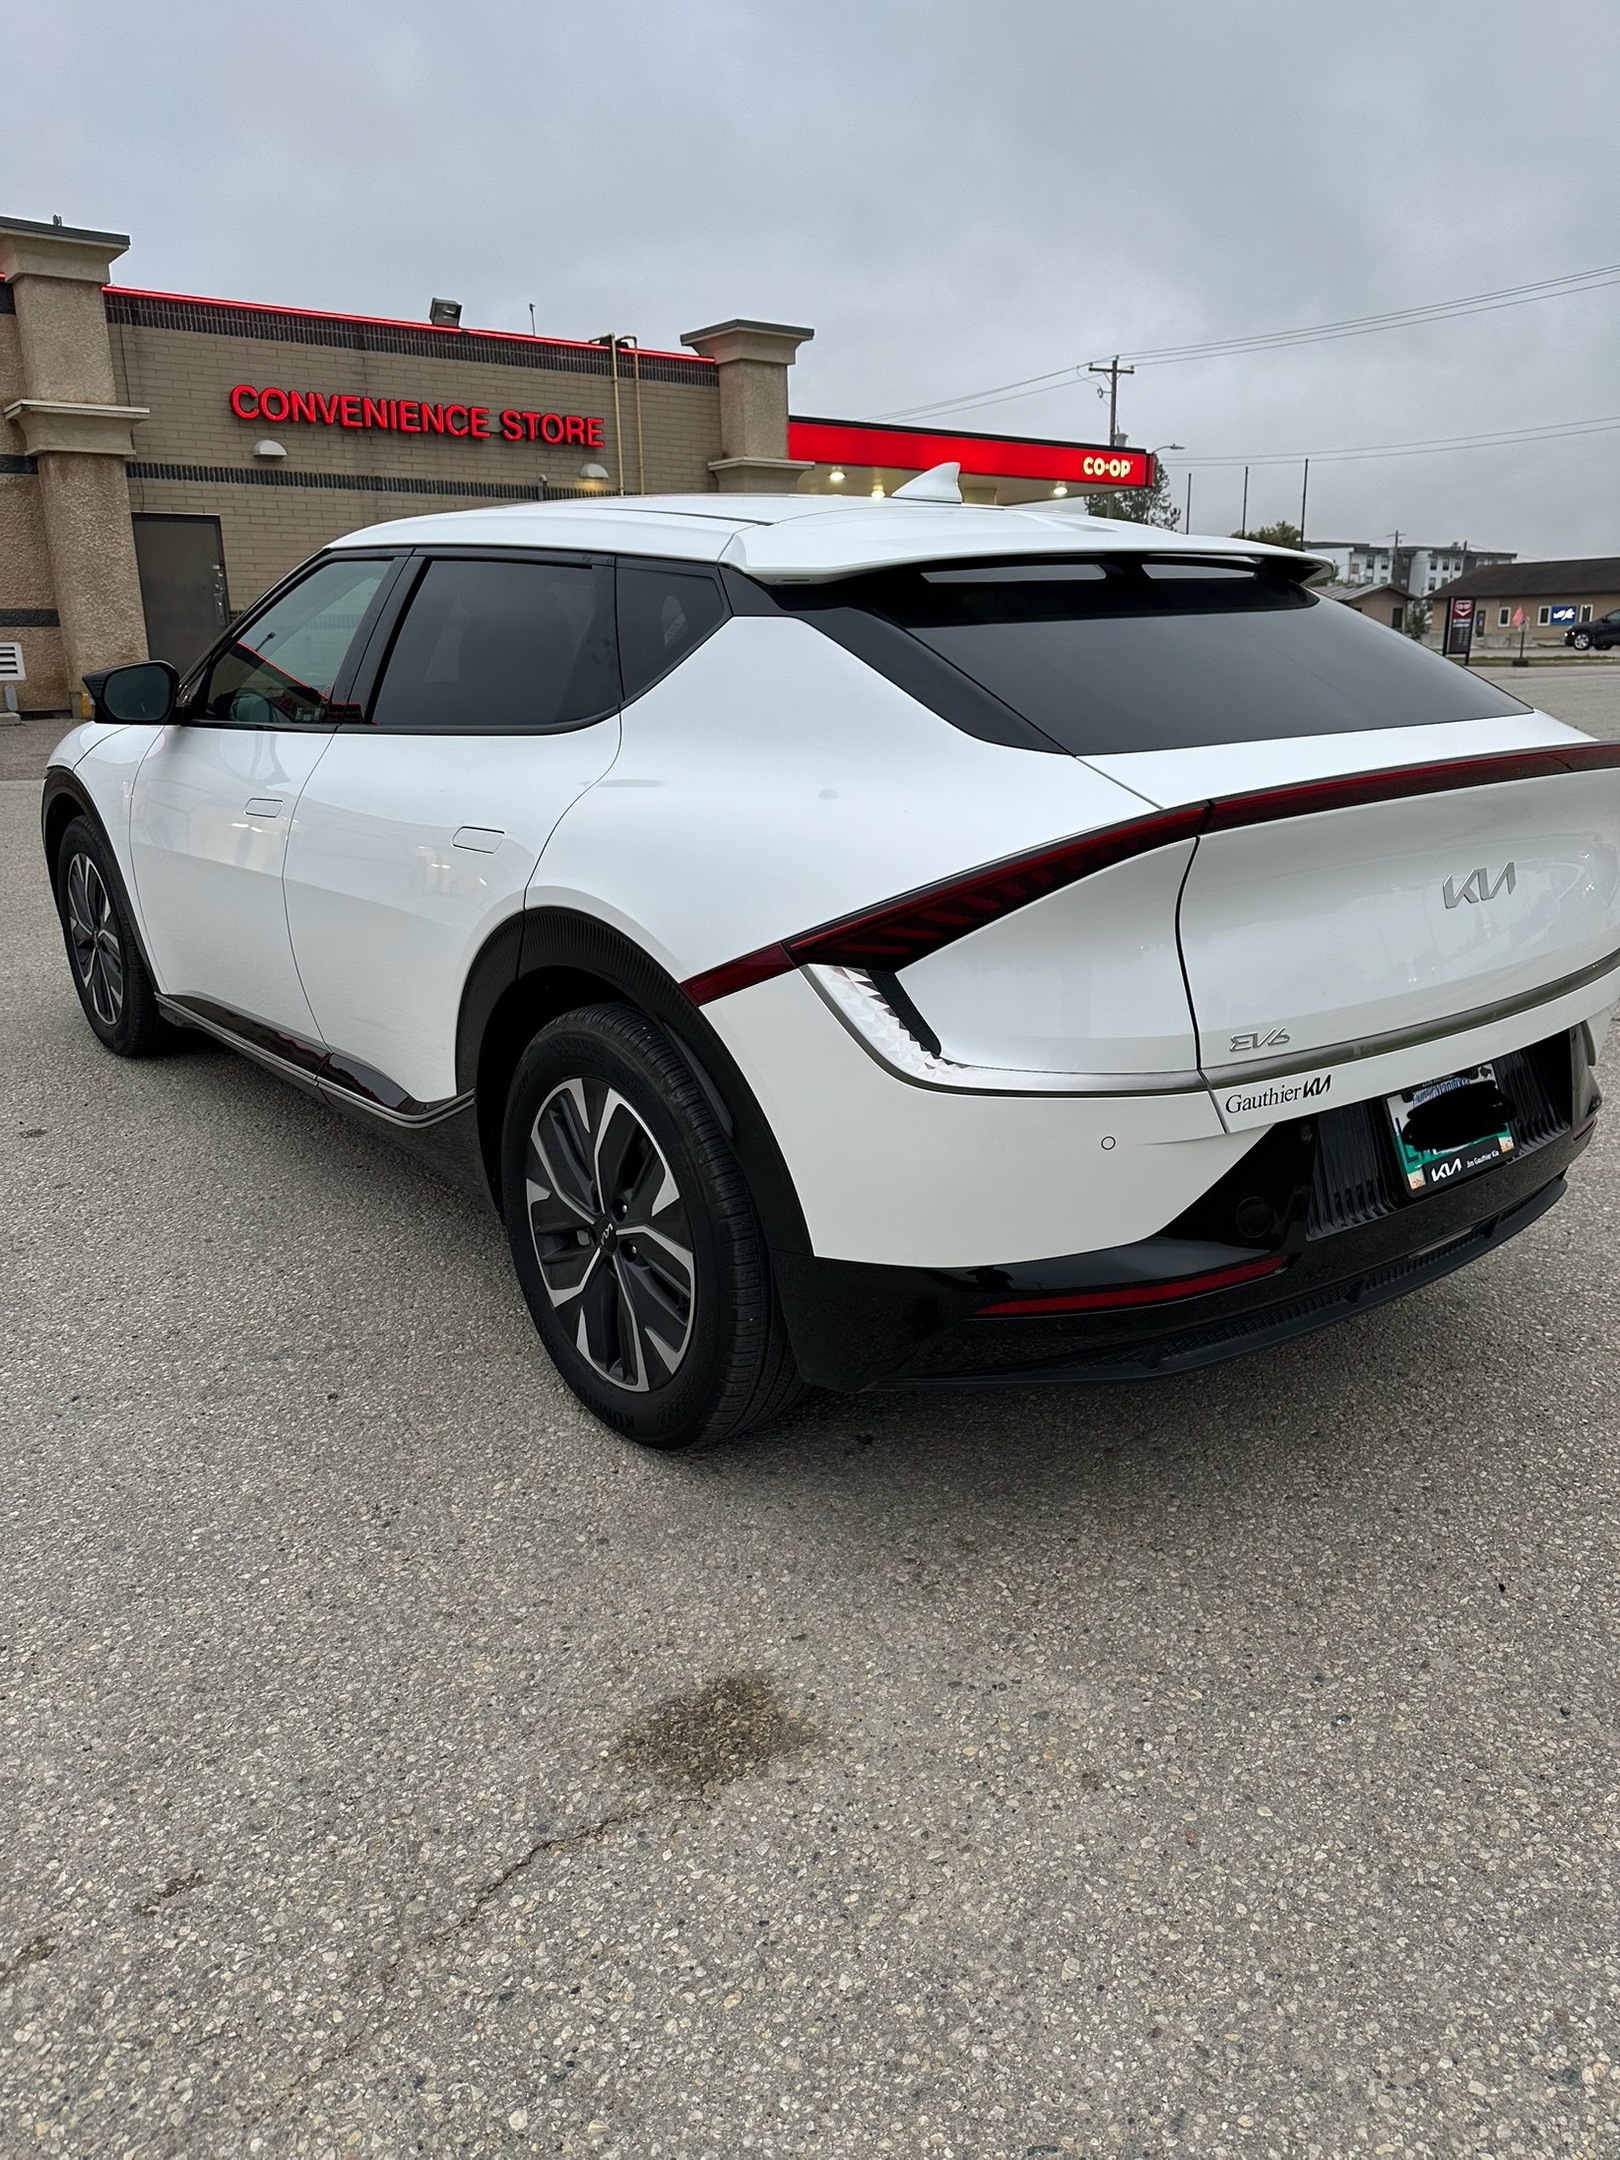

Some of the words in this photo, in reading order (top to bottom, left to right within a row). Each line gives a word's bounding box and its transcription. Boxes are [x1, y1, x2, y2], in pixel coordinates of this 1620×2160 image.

[230, 384, 491, 439] CONVENIENCE
[500, 409, 606, 448] STORE
[1228, 1026, 1291, 1053] EV6
[1225, 1084, 1302, 1115] Gauthier
